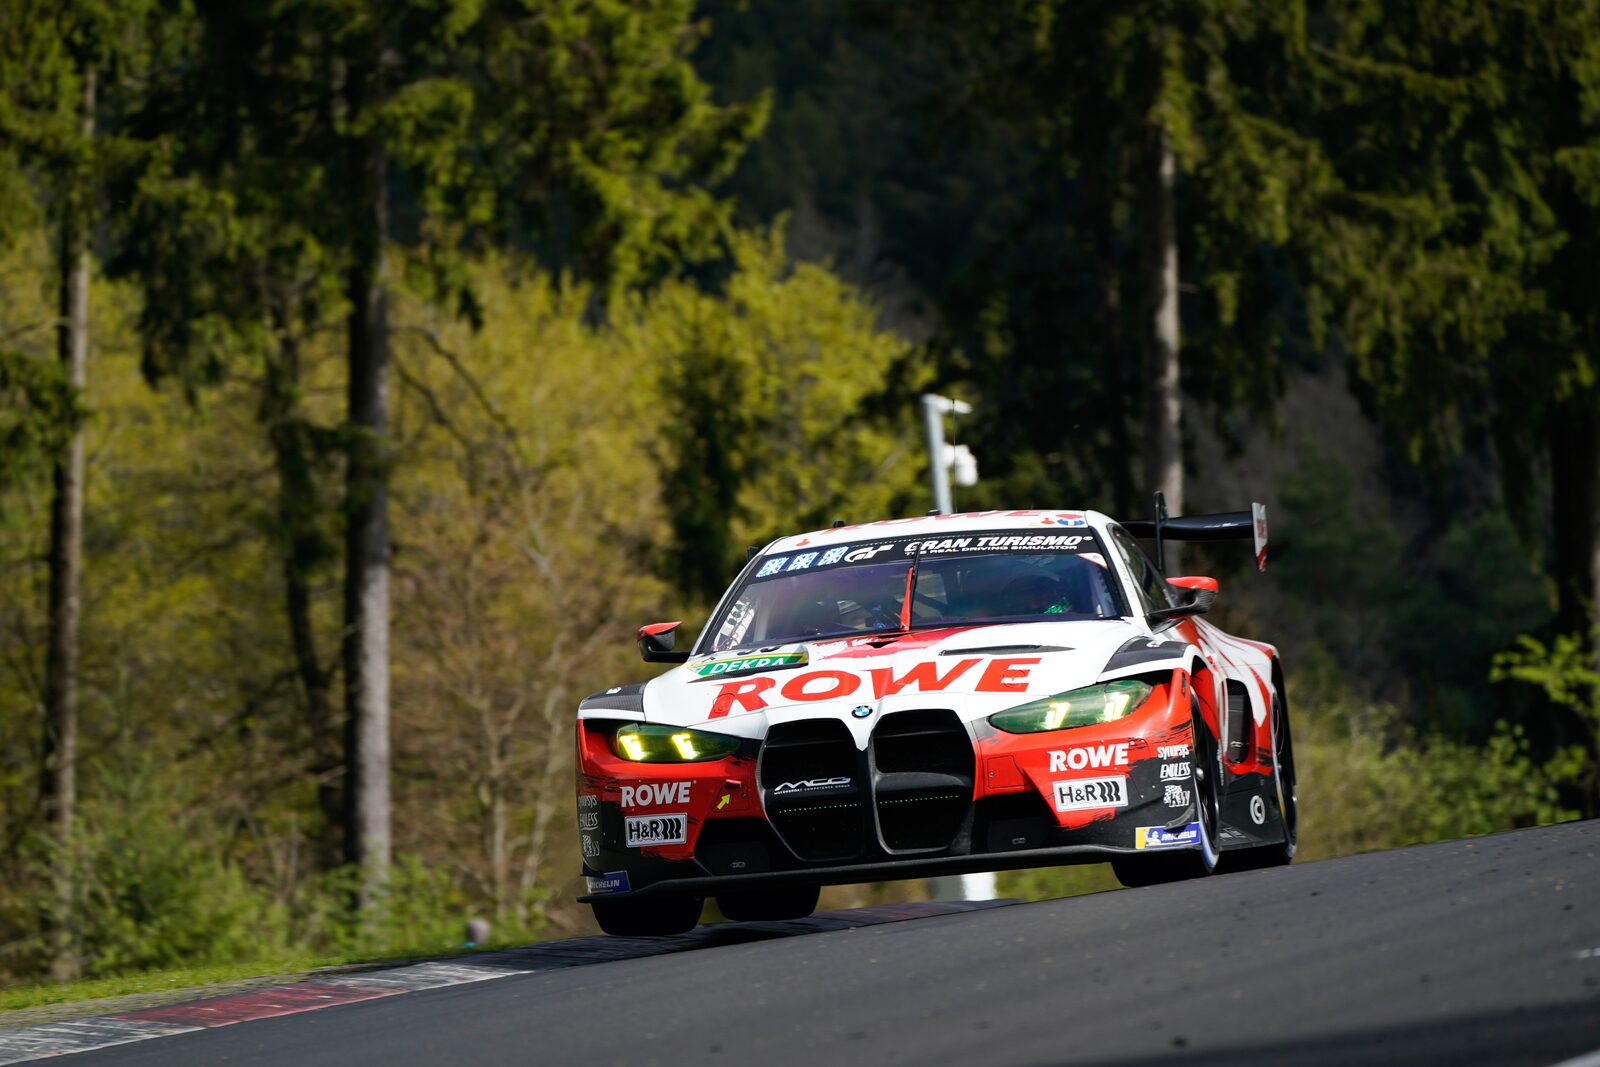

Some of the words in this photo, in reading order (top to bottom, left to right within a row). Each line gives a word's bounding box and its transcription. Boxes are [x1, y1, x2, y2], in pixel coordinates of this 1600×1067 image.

[904, 538, 972, 552] GRAN
[977, 536, 1082, 546] TURISMO
[709, 658, 784, 674] DEKRA
[707, 658, 1042, 720] ROWE
[1048, 743, 1129, 772] ROWE
[1160, 762, 1190, 778] ENDLESS
[620, 781, 691, 808] ROWE
